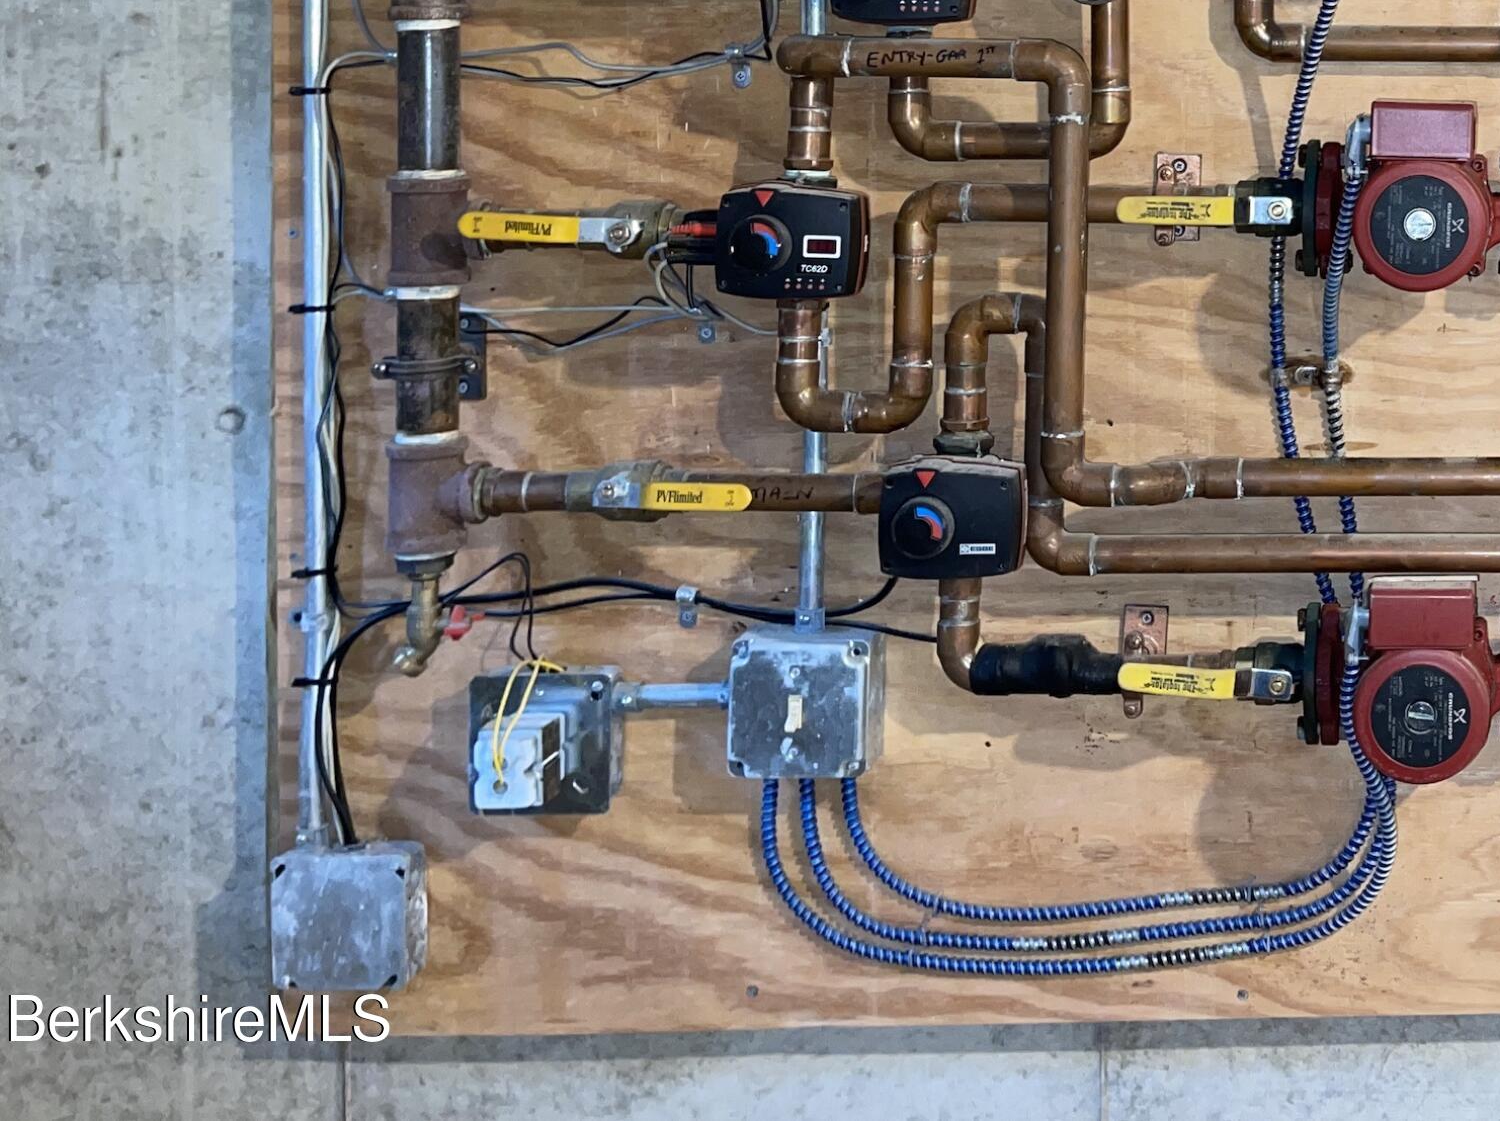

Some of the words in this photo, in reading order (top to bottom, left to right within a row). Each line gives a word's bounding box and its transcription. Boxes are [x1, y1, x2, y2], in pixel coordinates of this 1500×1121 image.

[504, 220, 553, 236] PVFlimited
[800, 264, 829, 274] TC62D
[656, 490, 703, 504] PVFlimited
